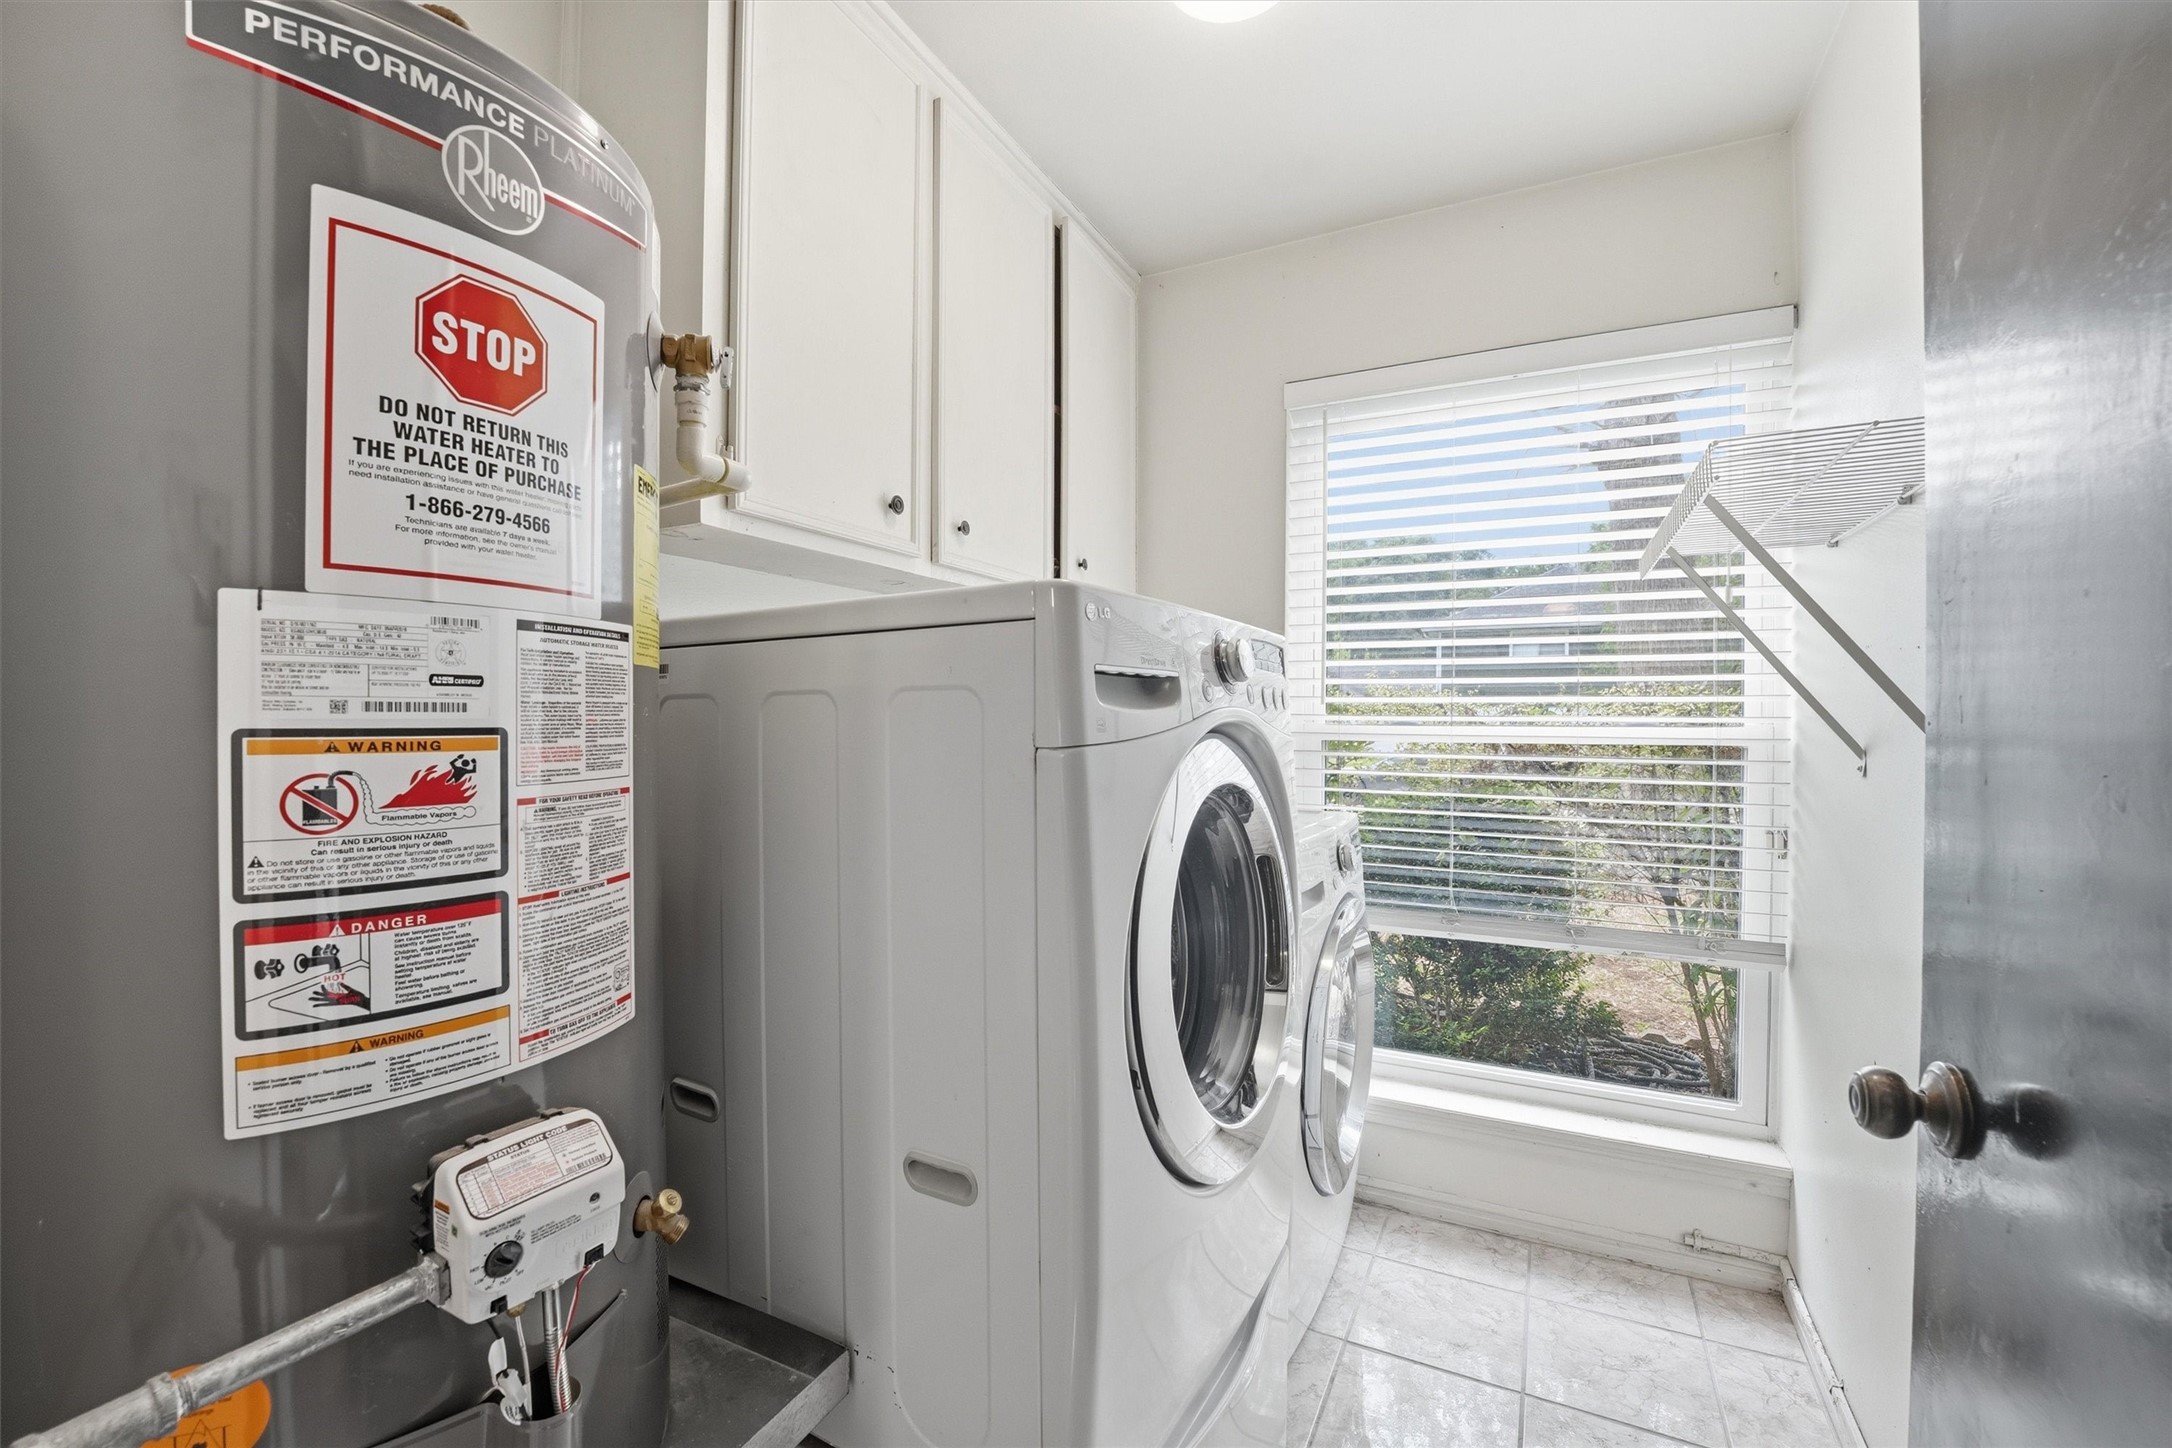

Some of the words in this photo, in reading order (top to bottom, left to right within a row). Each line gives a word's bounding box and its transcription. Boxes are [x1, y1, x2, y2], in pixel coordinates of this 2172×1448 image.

[245, 7, 525, 139] PERFORMANCE
[533, 124, 632, 216] PLATINUM
[456, 130, 539, 218] Rheem
[431, 311, 536, 377] STOP
[379, 395, 408, 417] DO
[416, 403, 456, 427] NOT
[463, 414, 531, 447] RETURN
[536, 434, 568, 458] THIS
[393, 420, 465, 450] WATER
[471, 438, 536, 468] HEATER
[541, 456, 559, 475] TO
[352, 436, 395, 460] THE
[404, 446, 468, 473] PLACE
[475, 460, 498, 479] OF
[504, 466, 581, 501] PURCHASE
[357, 462, 374, 470] you
[393, 467, 446, 482] experiencing
[448, 475, 473, 486] issues
[475, 481, 490, 490] with
[348, 470, 372, 478] need
[374, 473, 421, 486] installation
[423, 481, 465, 494] assistance
[405, 493, 551, 534] 1-866-279-4566
[405, 516, 453, 529] Technicians
[395, 524, 409, 532] For
[411, 527, 433, 536] more
[424, 538, 459, 550] provided
[461, 543, 476, 551] with
[478, 546, 494, 554] your
[1096, 607, 1111, 619] LG
[347, 740, 442, 753] WARNING
[381, 813, 428, 822] Flammable
[429, 811, 458, 820] Vapors
[310, 849, 328, 857] Can
[330, 846, 355, 855] result
[366, 844, 397, 852] serious
[398, 842, 420, 851] injury
[432, 839, 453, 847] death
[317, 839, 339, 848] FIRE
[342, 838, 361, 847] AND
[362, 834, 412, 845] EXPLOSION
[414, 831, 448, 840] HAZARD
[266, 860, 278, 868] Do
[280, 859, 293, 867] not
[351, 914, 427, 934] DANGER
[323, 972, 347, 983] HOT
[369, 1029, 424, 1048] WARNING
[487, 1144, 520, 1161] STATUS
[521, 1134, 544, 1146] LIGHT
[546, 1125, 568, 1138] CODE
